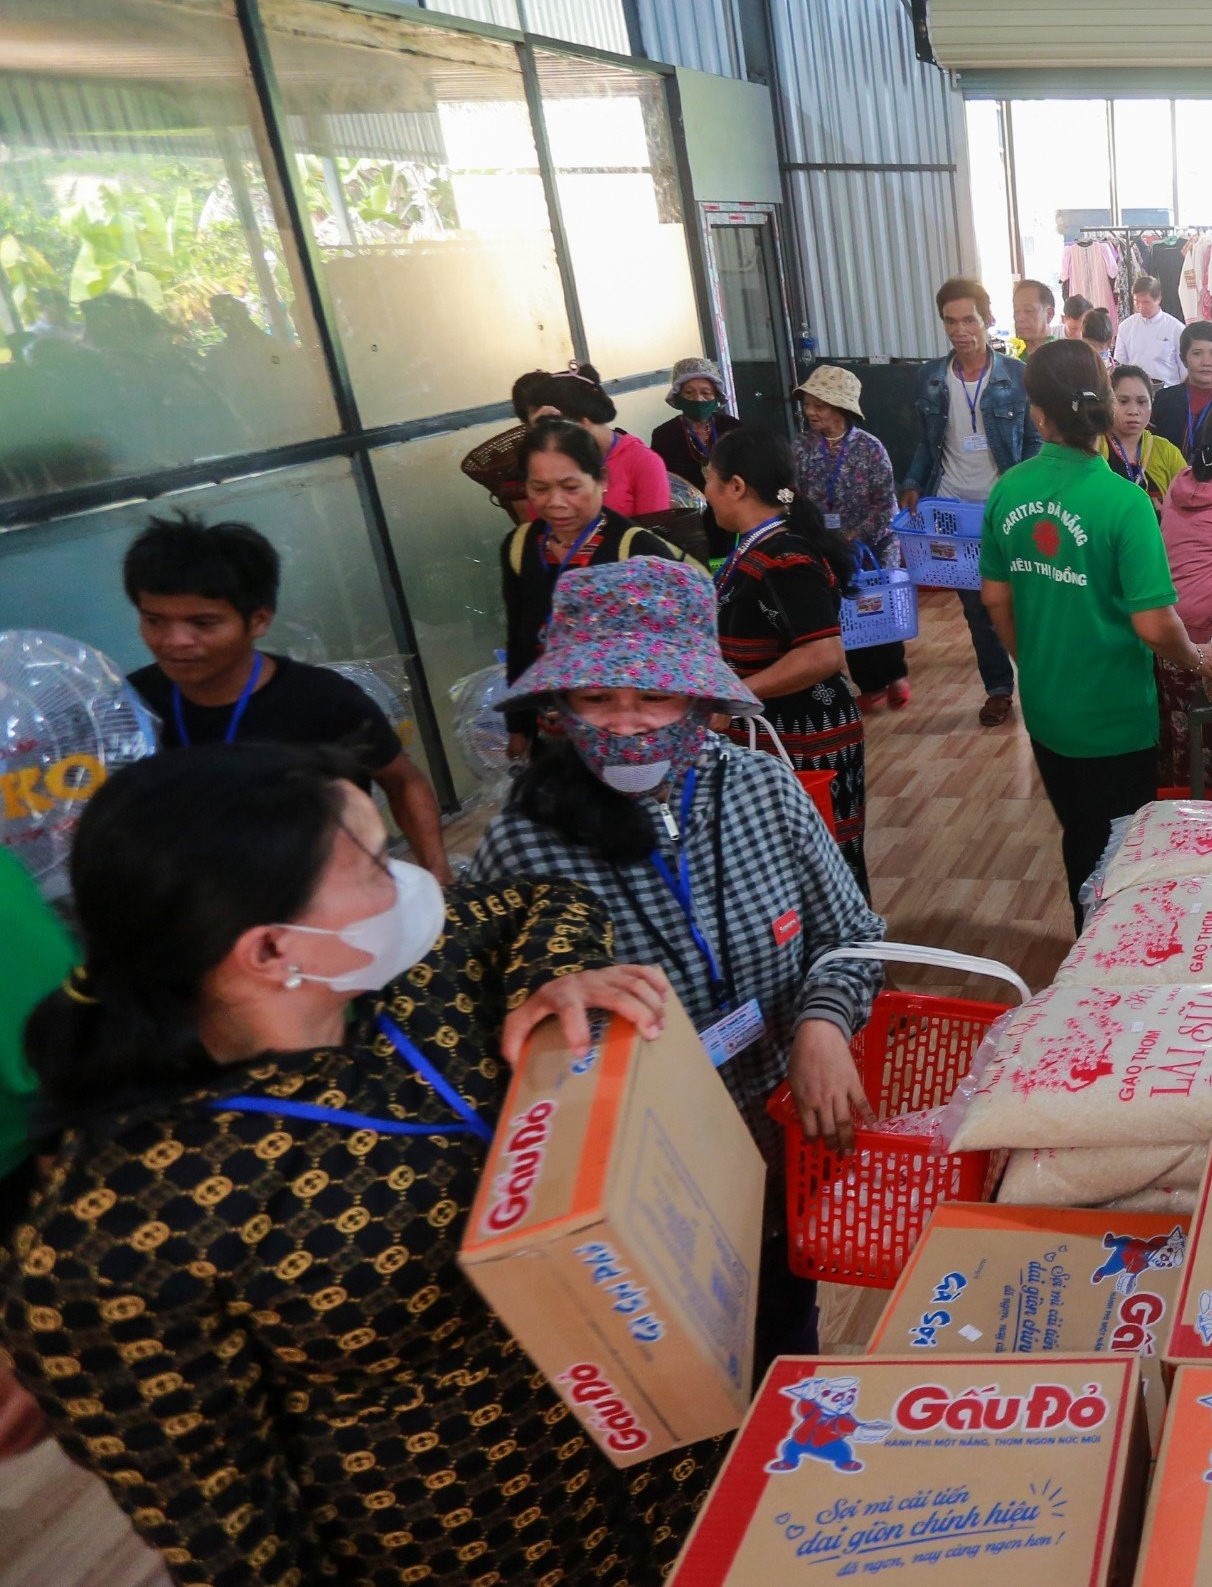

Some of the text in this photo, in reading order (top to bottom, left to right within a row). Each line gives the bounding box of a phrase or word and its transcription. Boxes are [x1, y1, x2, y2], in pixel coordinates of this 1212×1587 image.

[1002, 501, 1044, 535] CARITAS
[1047, 501, 1061, 517] ĐÀ
[1144, 1046, 1206, 1097] LÀI
[932, 1272, 967, 1302] Gà
[1111, 1294, 1163, 1356] Gấ
[896, 1384, 1106, 1431] Gấu Đỏ
[816, 1484, 969, 1525] Sợi mì cải tiến
[796, 1500, 1041, 1557] dai giòn chính hiệu
[912, 1550, 941, 1565] nay
[946, 1543, 980, 1561] càng
[985, 1536, 1023, 1555] ngon
